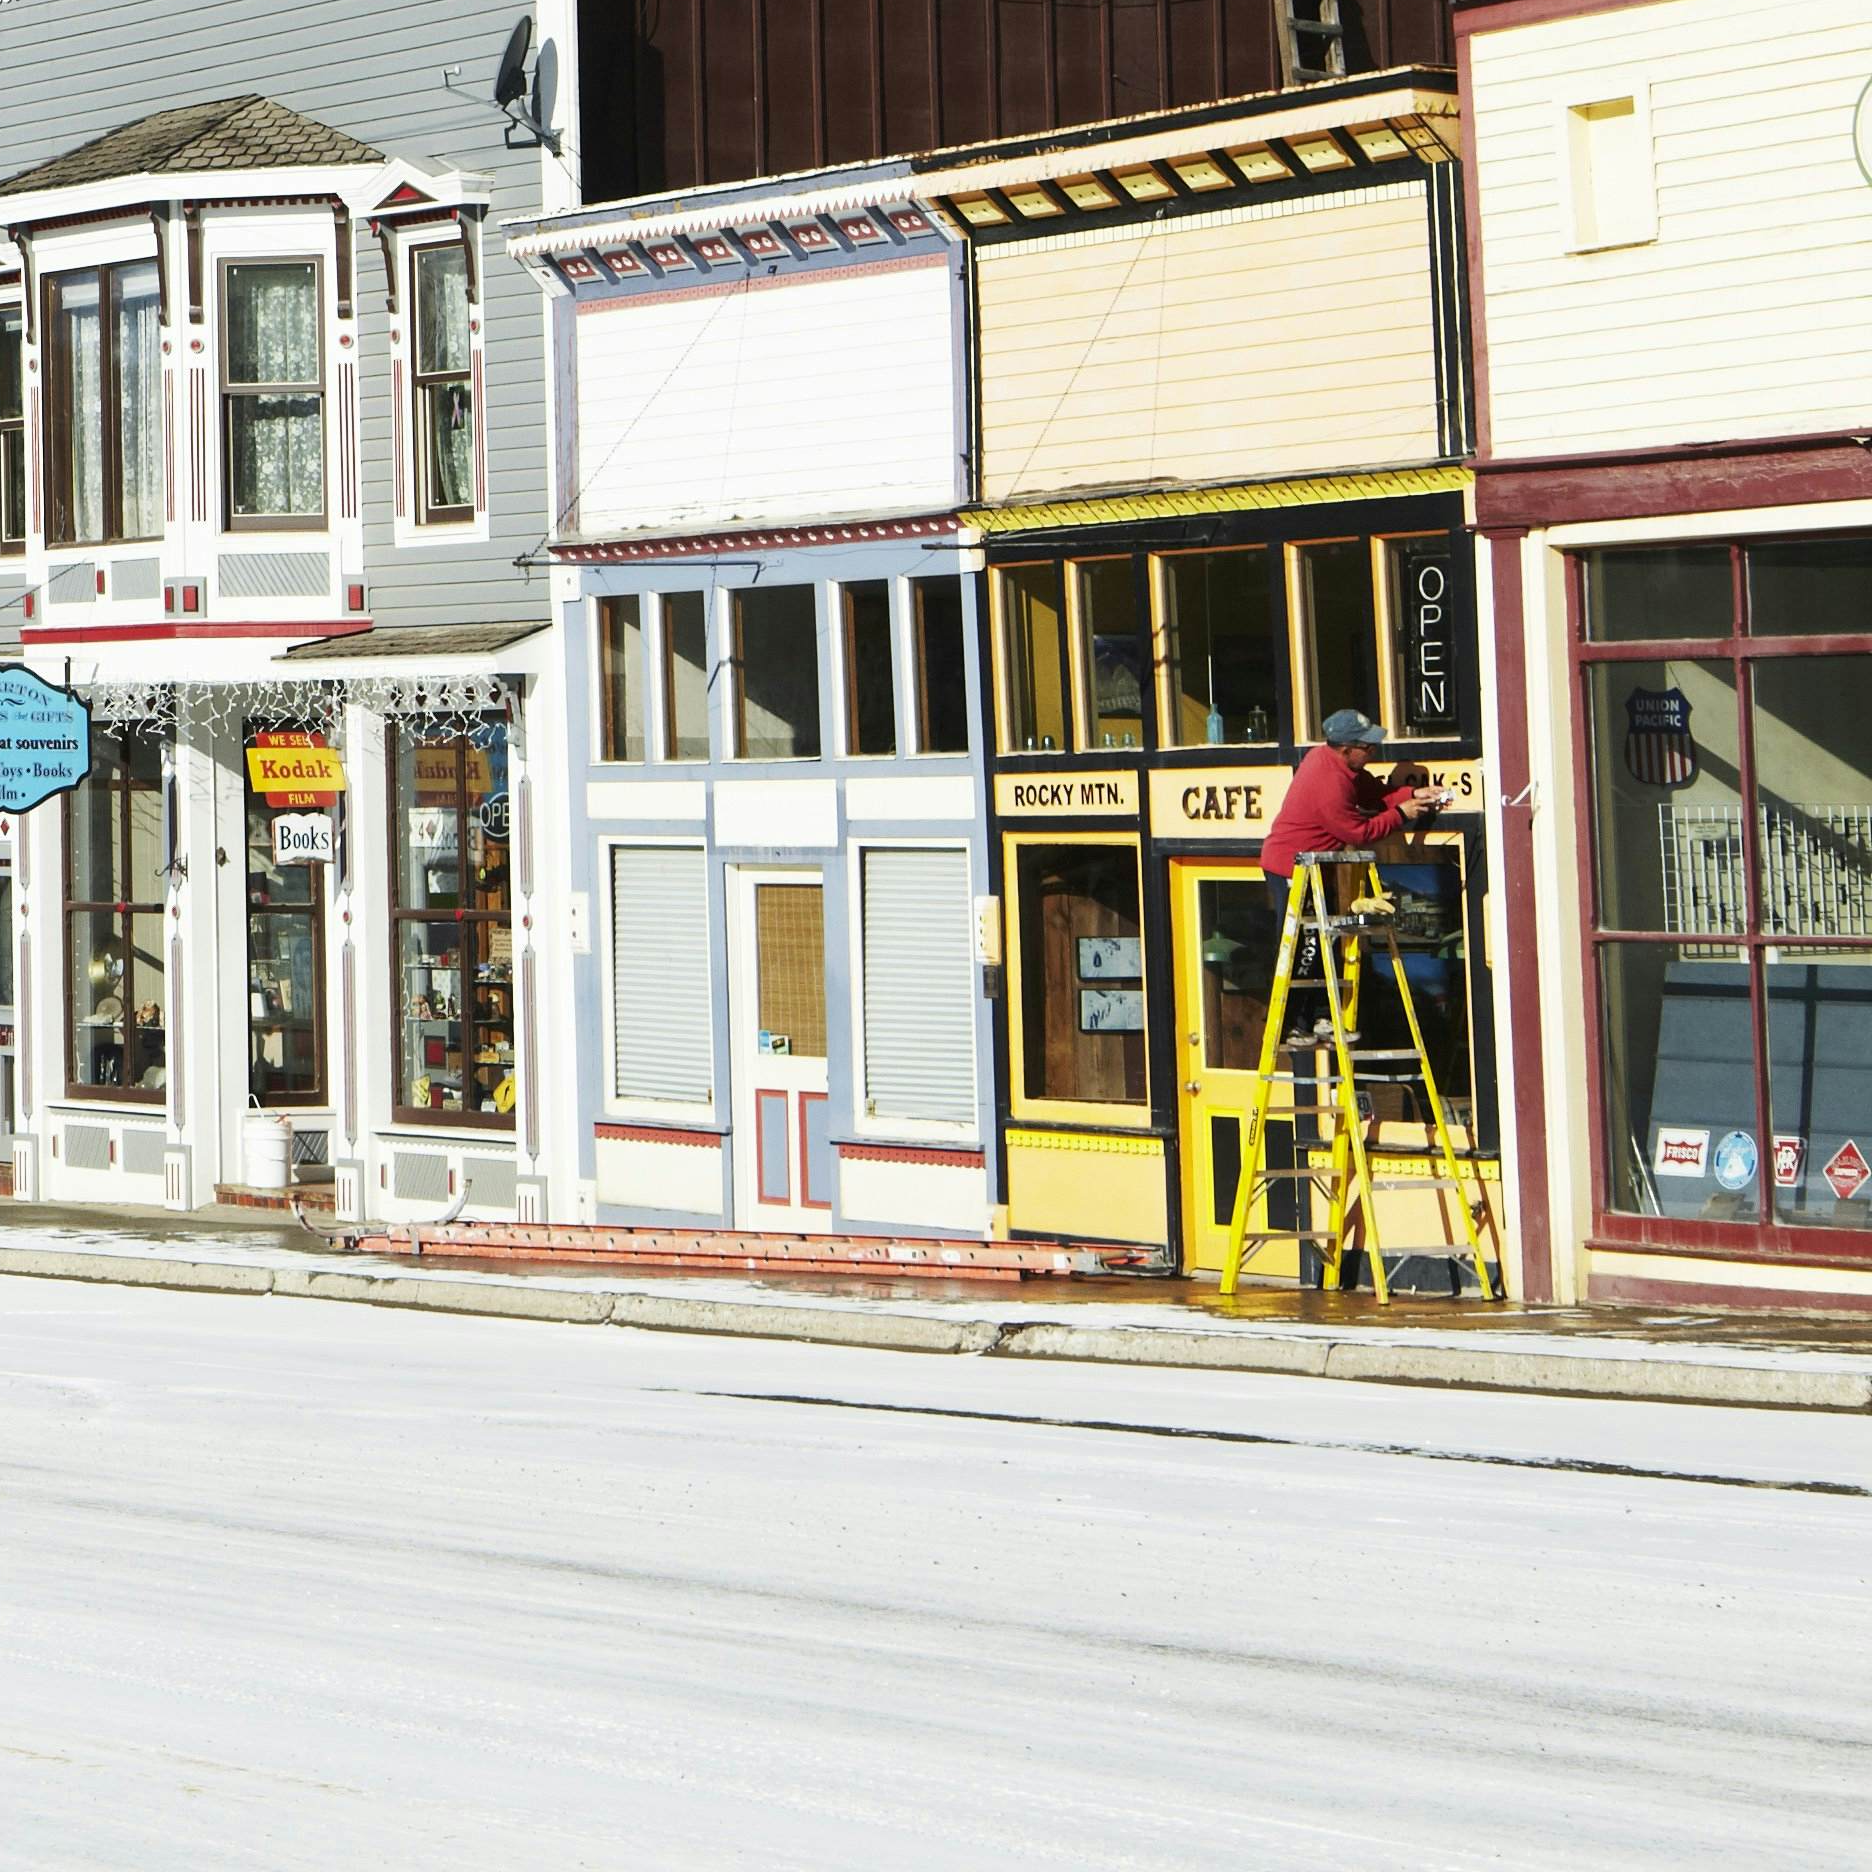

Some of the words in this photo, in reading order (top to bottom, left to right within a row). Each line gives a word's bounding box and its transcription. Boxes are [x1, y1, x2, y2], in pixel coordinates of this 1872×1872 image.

[1418, 566, 1445, 713] OPEN
[1636, 699, 1680, 711] UNION
[30, 710, 73, 723] GIFTS
[1635, 714, 1682, 727] PACIFIC
[15, 734, 79, 750] souvenirs
[268, 735, 286, 746] WE
[289, 735, 311, 746] SEL
[33, 762, 73, 778] Books
[260, 760, 333, 779] Kodak
[287, 793, 316, 805] FILM
[1014, 783, 1074, 807] ROCKY
[1080, 782, 1125, 805] MTN.
[1182, 785, 1263, 820] CAFE
[480, 802, 509, 826] OPE
[279, 825, 329, 851] Books
[1666, 1147, 1697, 1160] FRISCO
